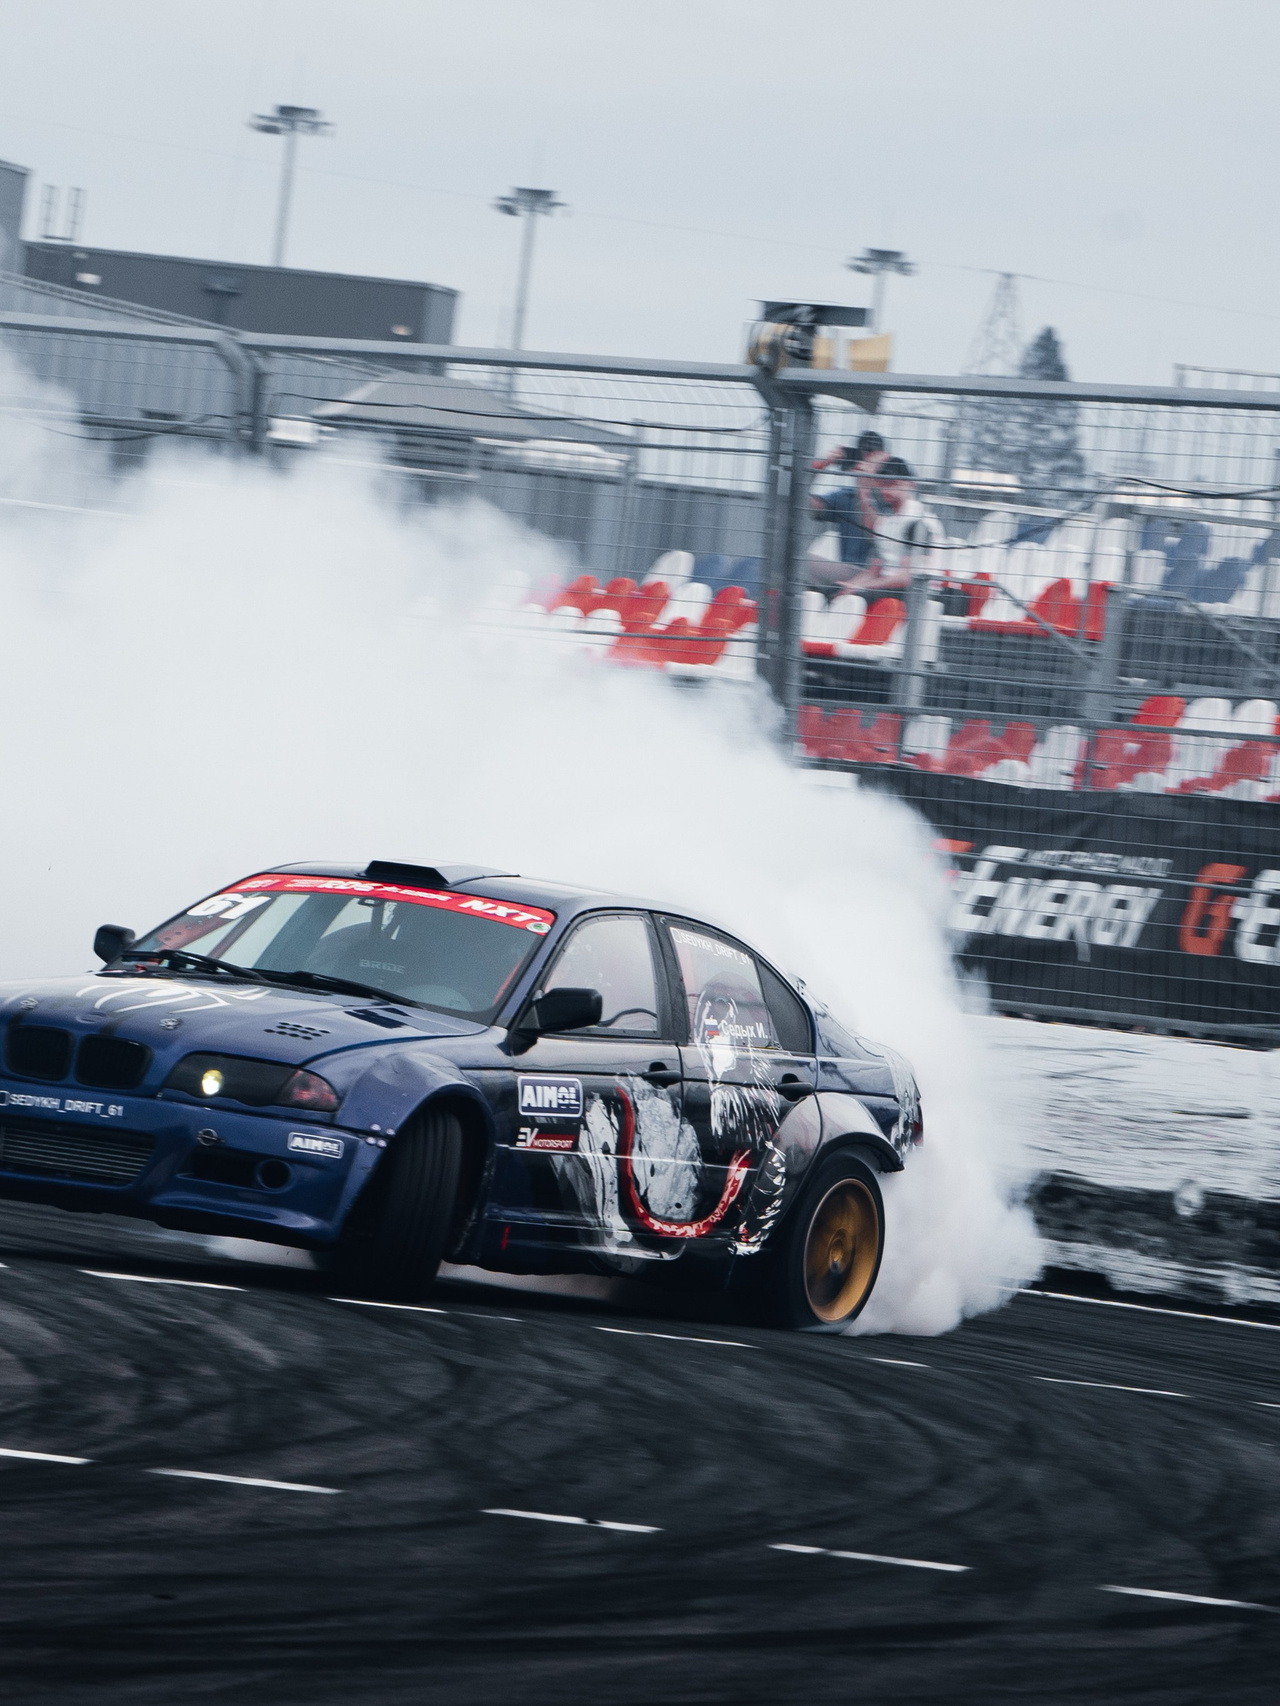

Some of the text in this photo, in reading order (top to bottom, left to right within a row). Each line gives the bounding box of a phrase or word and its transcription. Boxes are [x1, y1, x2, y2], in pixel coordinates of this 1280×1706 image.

[186, 893, 272, 920] 61
[458, 900, 543, 922] NXT
[359, 959, 405, 974] BRIDE
[720, 1020, 755, 1039] Седых
[522, 1085, 580, 1109] AIMOL
[532, 1139, 574, 1149] MOTORSPORT
